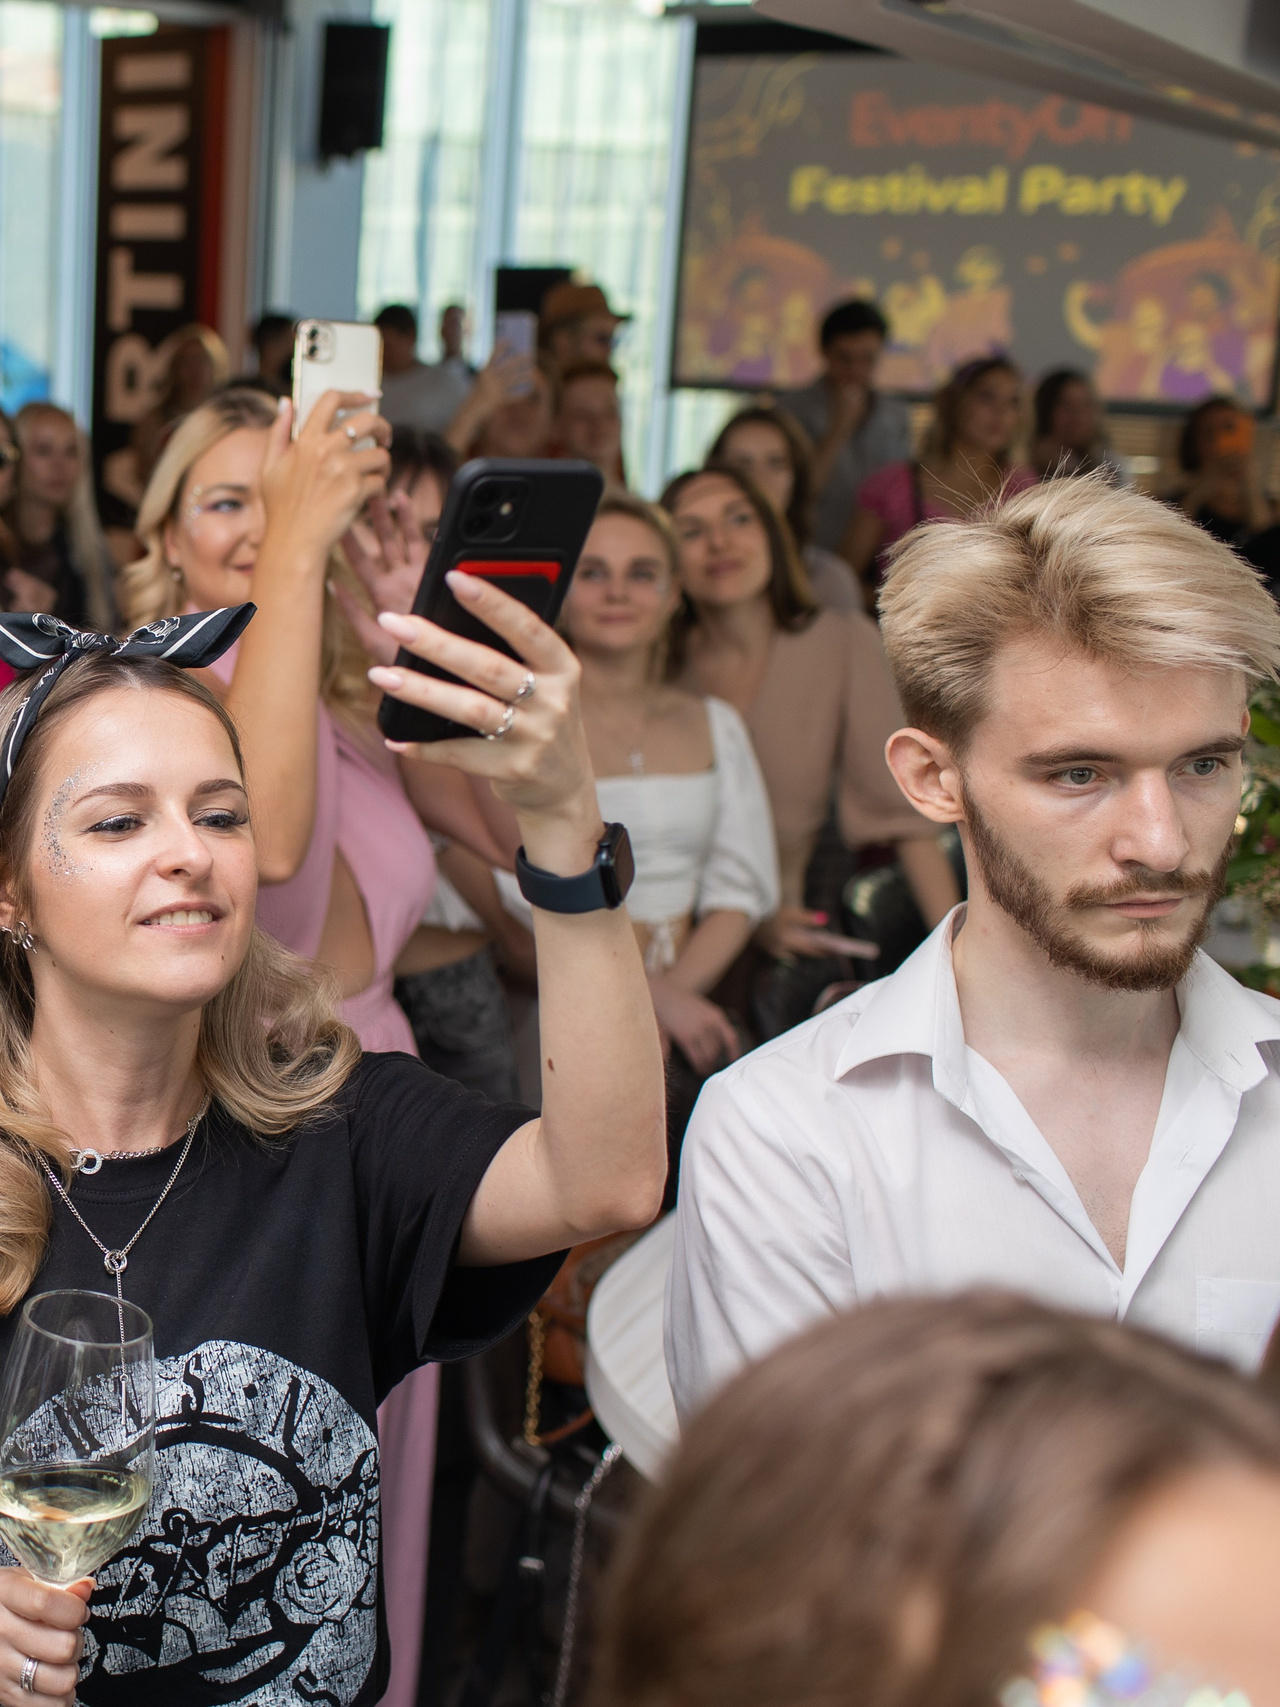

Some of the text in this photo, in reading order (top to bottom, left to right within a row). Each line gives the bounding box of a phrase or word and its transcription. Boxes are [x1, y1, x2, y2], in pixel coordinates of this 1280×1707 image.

[103, 51, 192, 500] RTINI
[789, 163, 1187, 225] Festival Party
